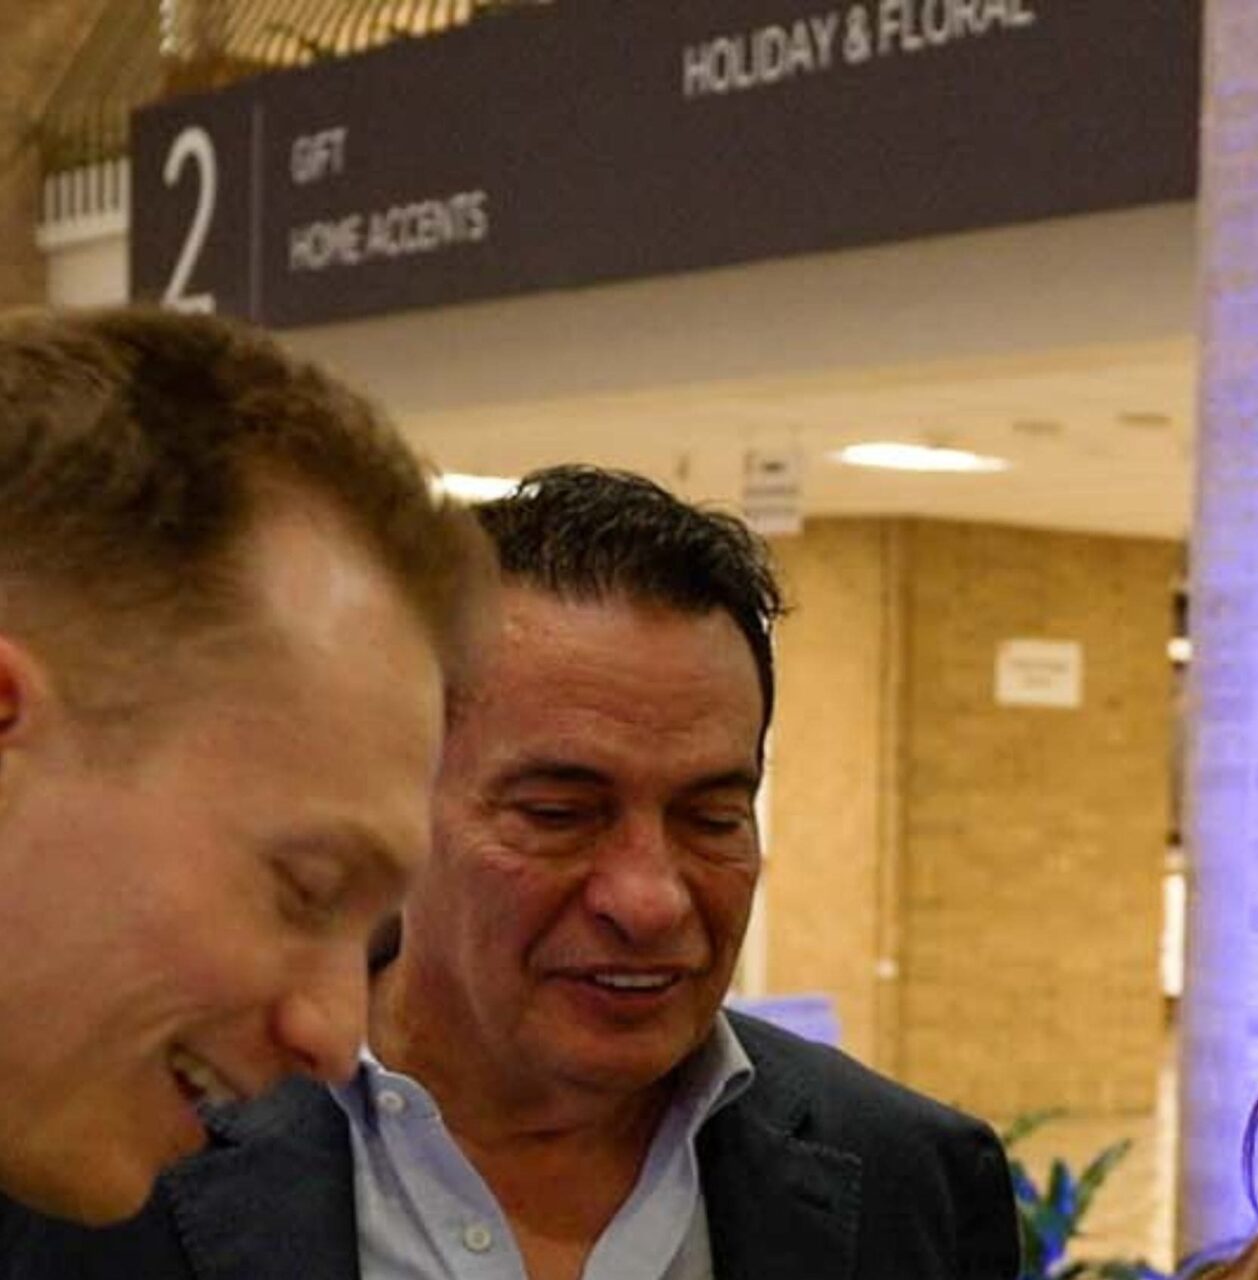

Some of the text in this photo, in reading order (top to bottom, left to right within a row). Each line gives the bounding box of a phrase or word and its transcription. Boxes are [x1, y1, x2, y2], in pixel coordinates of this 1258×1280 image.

[684, 11, 839, 96] HOLIDAY
[843, 3, 873, 65] &
[162, 125, 217, 315] 2
[290, 189, 488, 272] HOME ACCENTS
